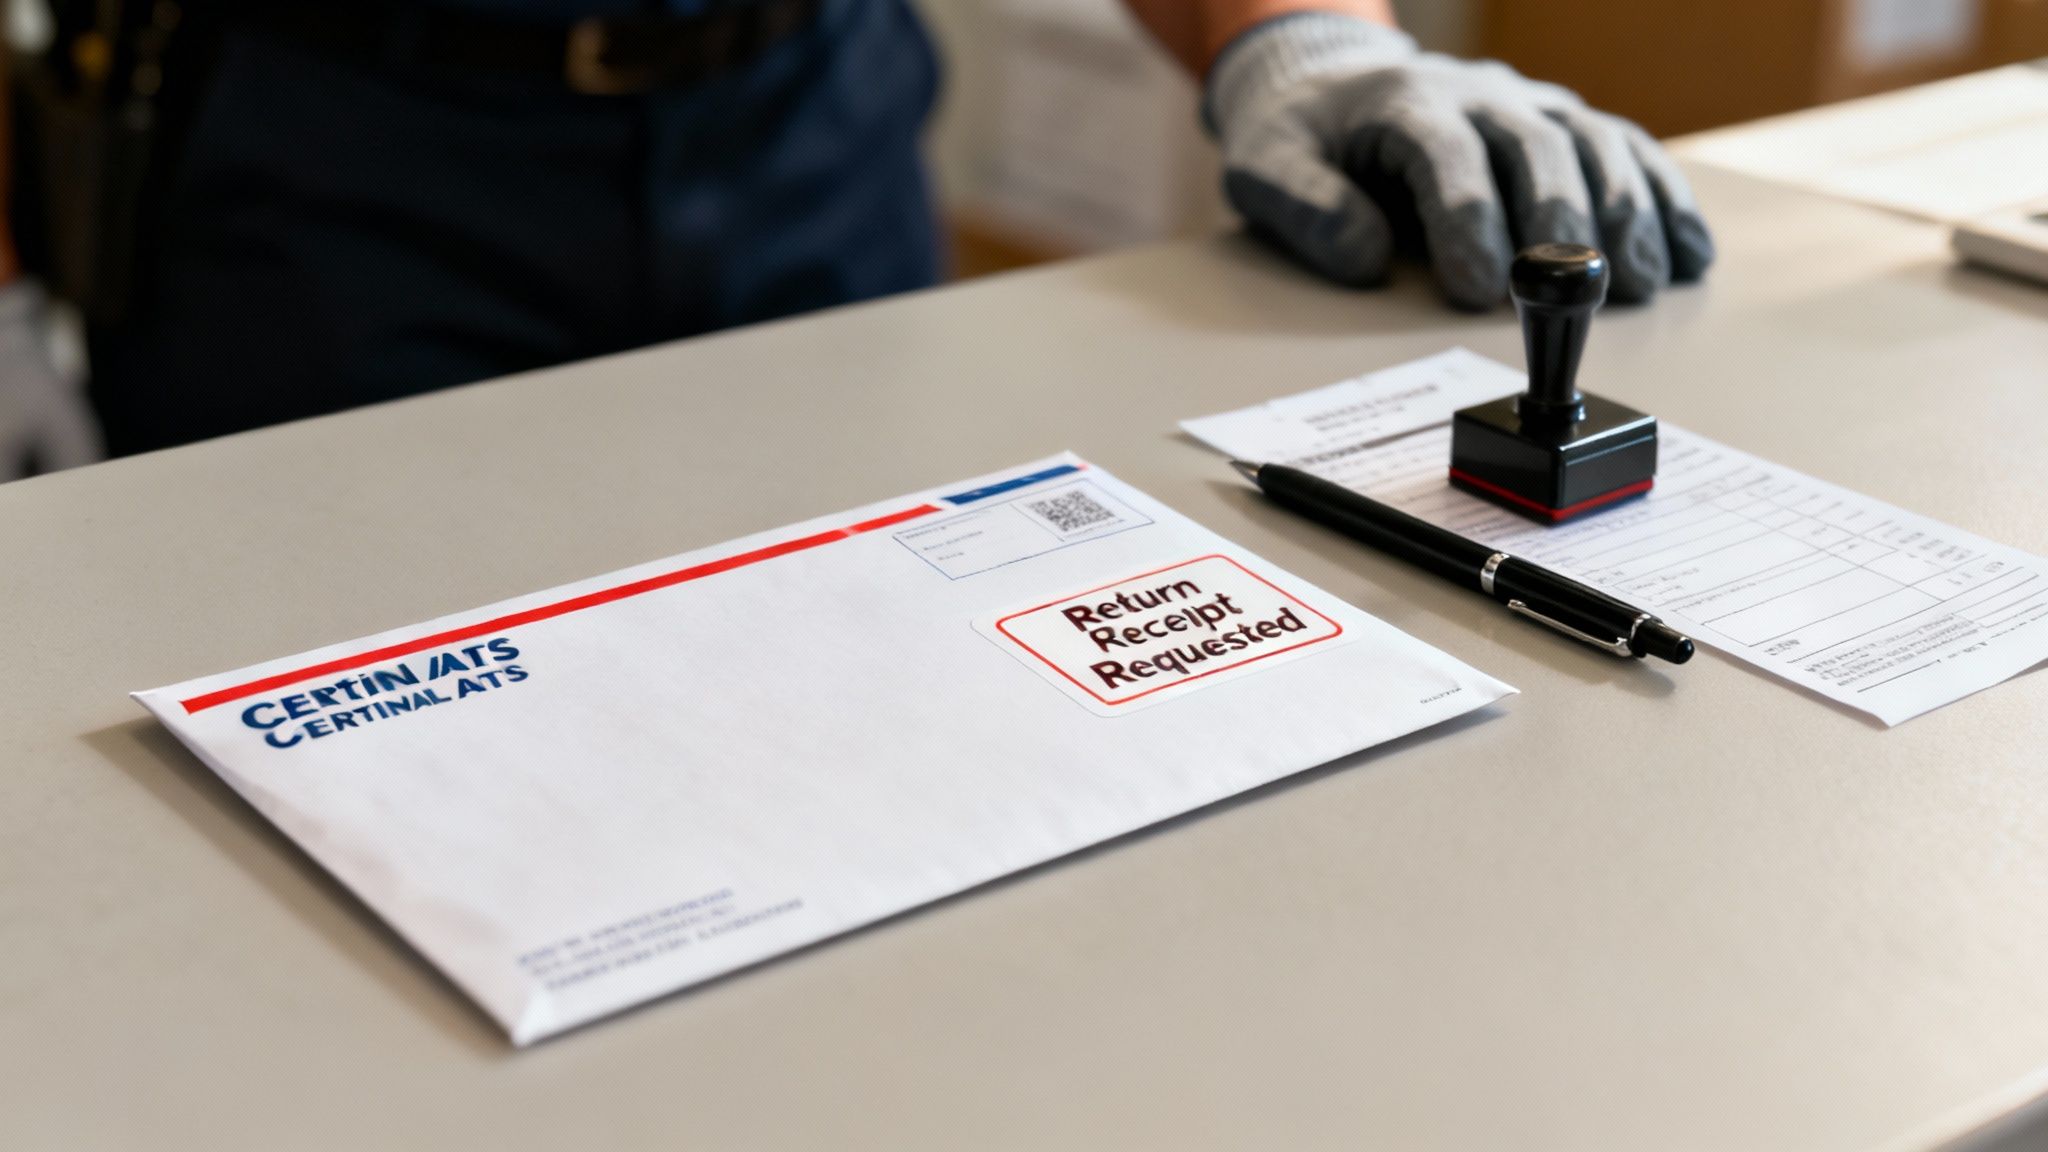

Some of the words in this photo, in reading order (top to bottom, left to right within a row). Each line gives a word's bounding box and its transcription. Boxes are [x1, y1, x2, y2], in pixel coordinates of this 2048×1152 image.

[1061, 579, 1202, 632] Return
[1090, 607, 1307, 689] Requested
[458, 665, 528, 699] ATS
